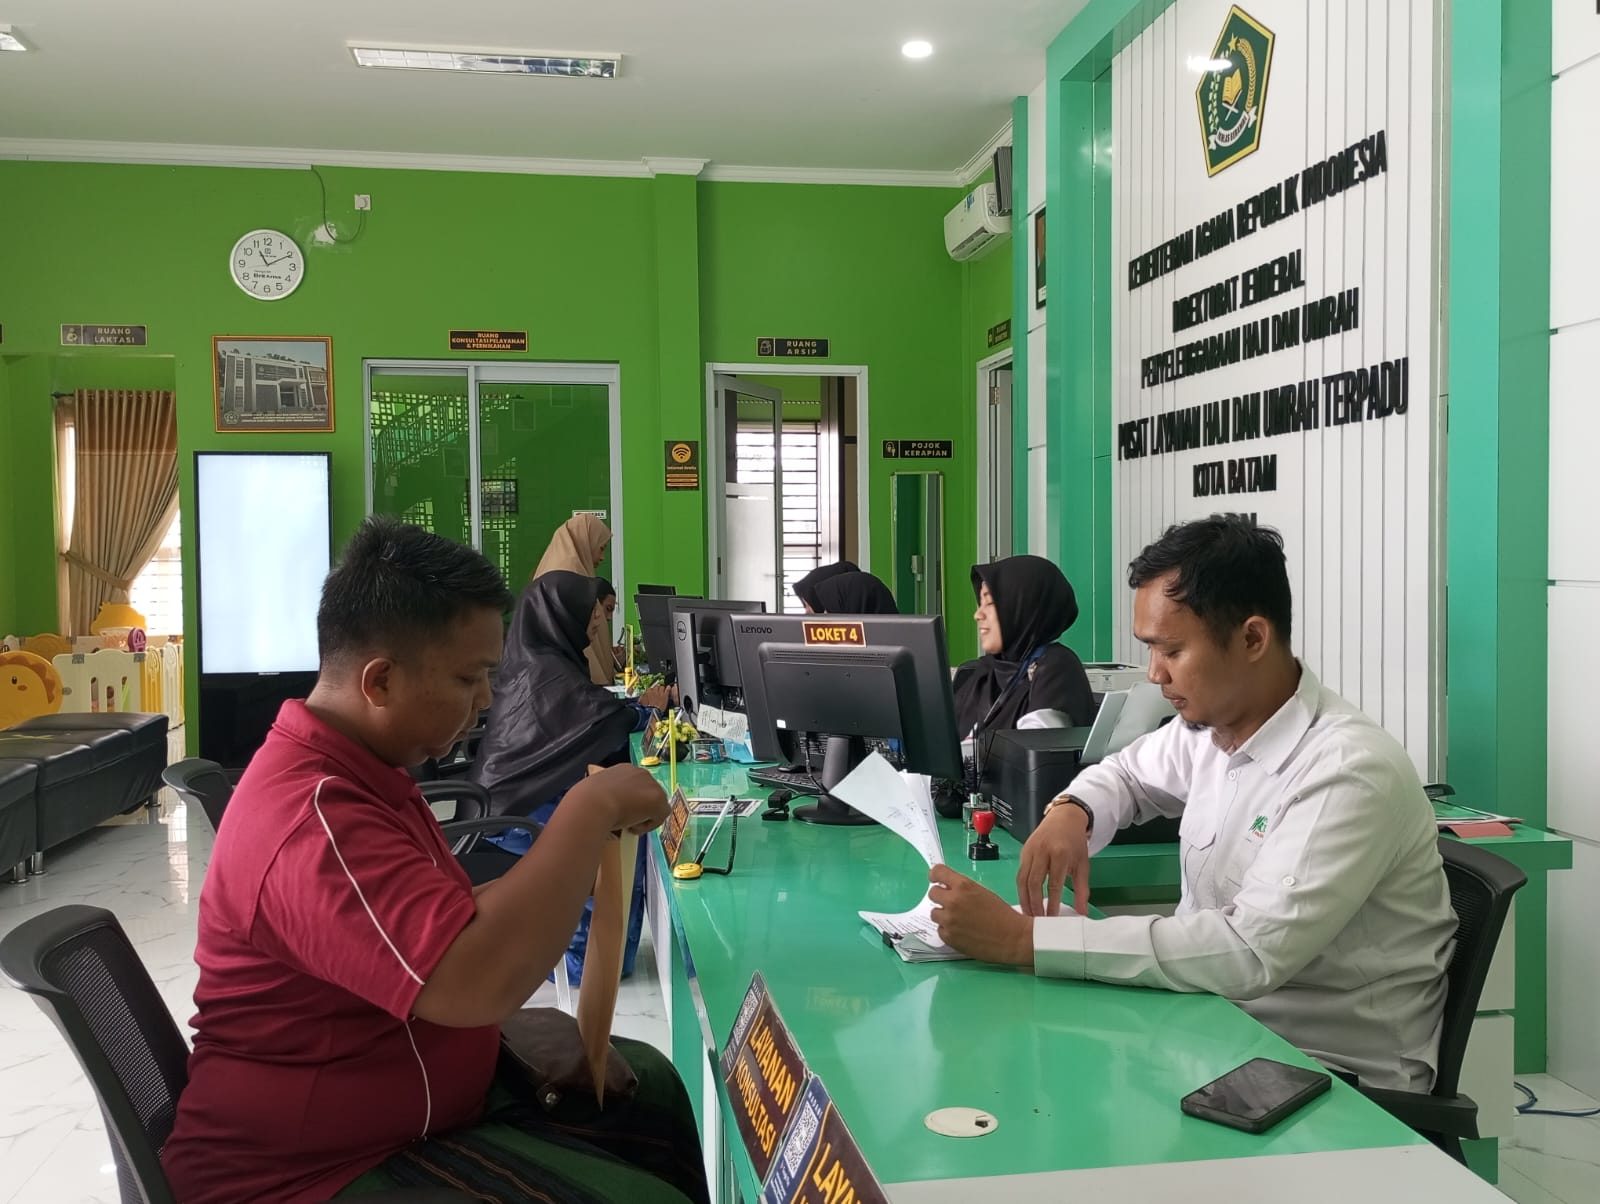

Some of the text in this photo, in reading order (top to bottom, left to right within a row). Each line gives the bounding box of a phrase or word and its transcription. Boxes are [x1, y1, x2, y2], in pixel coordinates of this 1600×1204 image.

[1128, 130, 1388, 291] KEMENTERIAN AGAMA REPUBLIK INDONESIA
[253, 240, 260, 248] 11
[263, 237, 273, 246] 12
[243, 247, 253, 256] 10
[238, 260, 246, 268] 9
[288, 263, 297, 271] 3
[242, 272, 250, 280] 8
[252, 281, 258, 289] 7
[263, 285, 271, 293] 6
[275, 282, 283, 291] 5
[1172, 248, 1305, 333] DIREKTORAT JENDERAL
[97, 327, 131, 335] RUANG
[94, 336, 135, 344] LAKTASI
[1141, 287, 1359, 389] PENYELENGGARAAN HAJI DAN UMRAH
[1118, 357, 1409, 461] PUSAT LAYANAN HAJI DAN UMRAH TERPADU
[1193, 454, 1277, 497] KOTA BATAM
[740, 625, 773, 634] Lenovo
[810, 627, 858, 641] LOKET 4
[749, 1015, 797, 1116] LAYANAN
[735, 1054, 777, 1159] KONSULTASI
